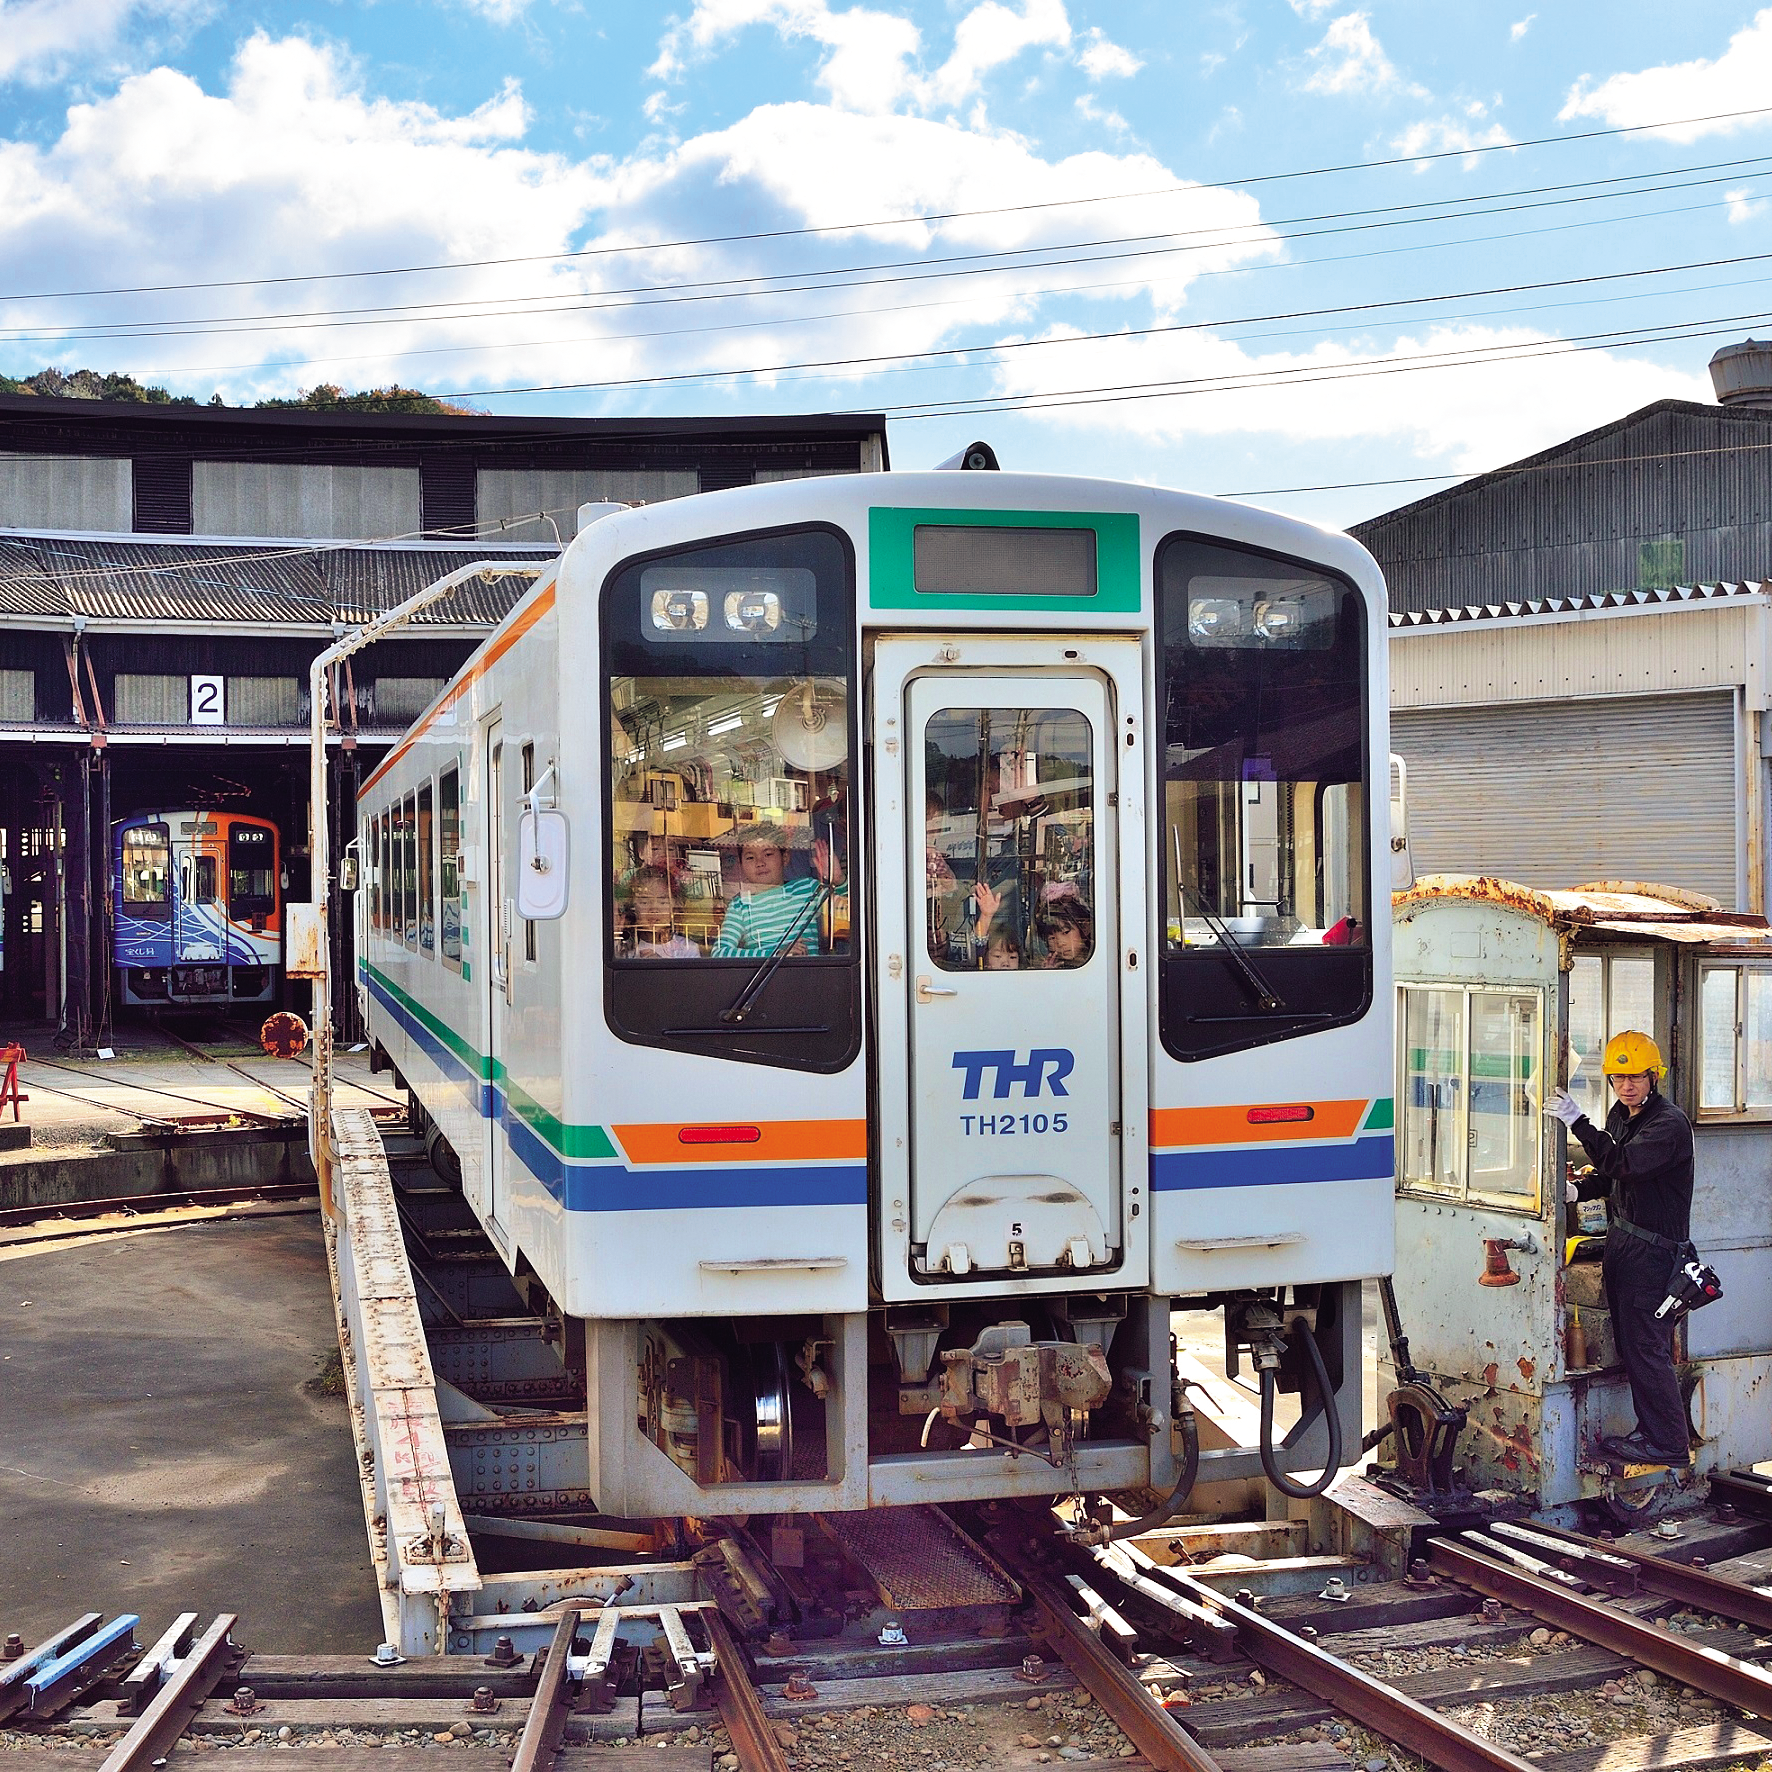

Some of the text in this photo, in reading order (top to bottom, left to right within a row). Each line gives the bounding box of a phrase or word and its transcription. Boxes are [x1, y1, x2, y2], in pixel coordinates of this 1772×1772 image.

[197, 682, 219, 713] 2
[951, 1048, 1075, 1100] THR
[959, 1113, 1069, 1136] TH2105
[1011, 1222, 1023, 1237] 5
